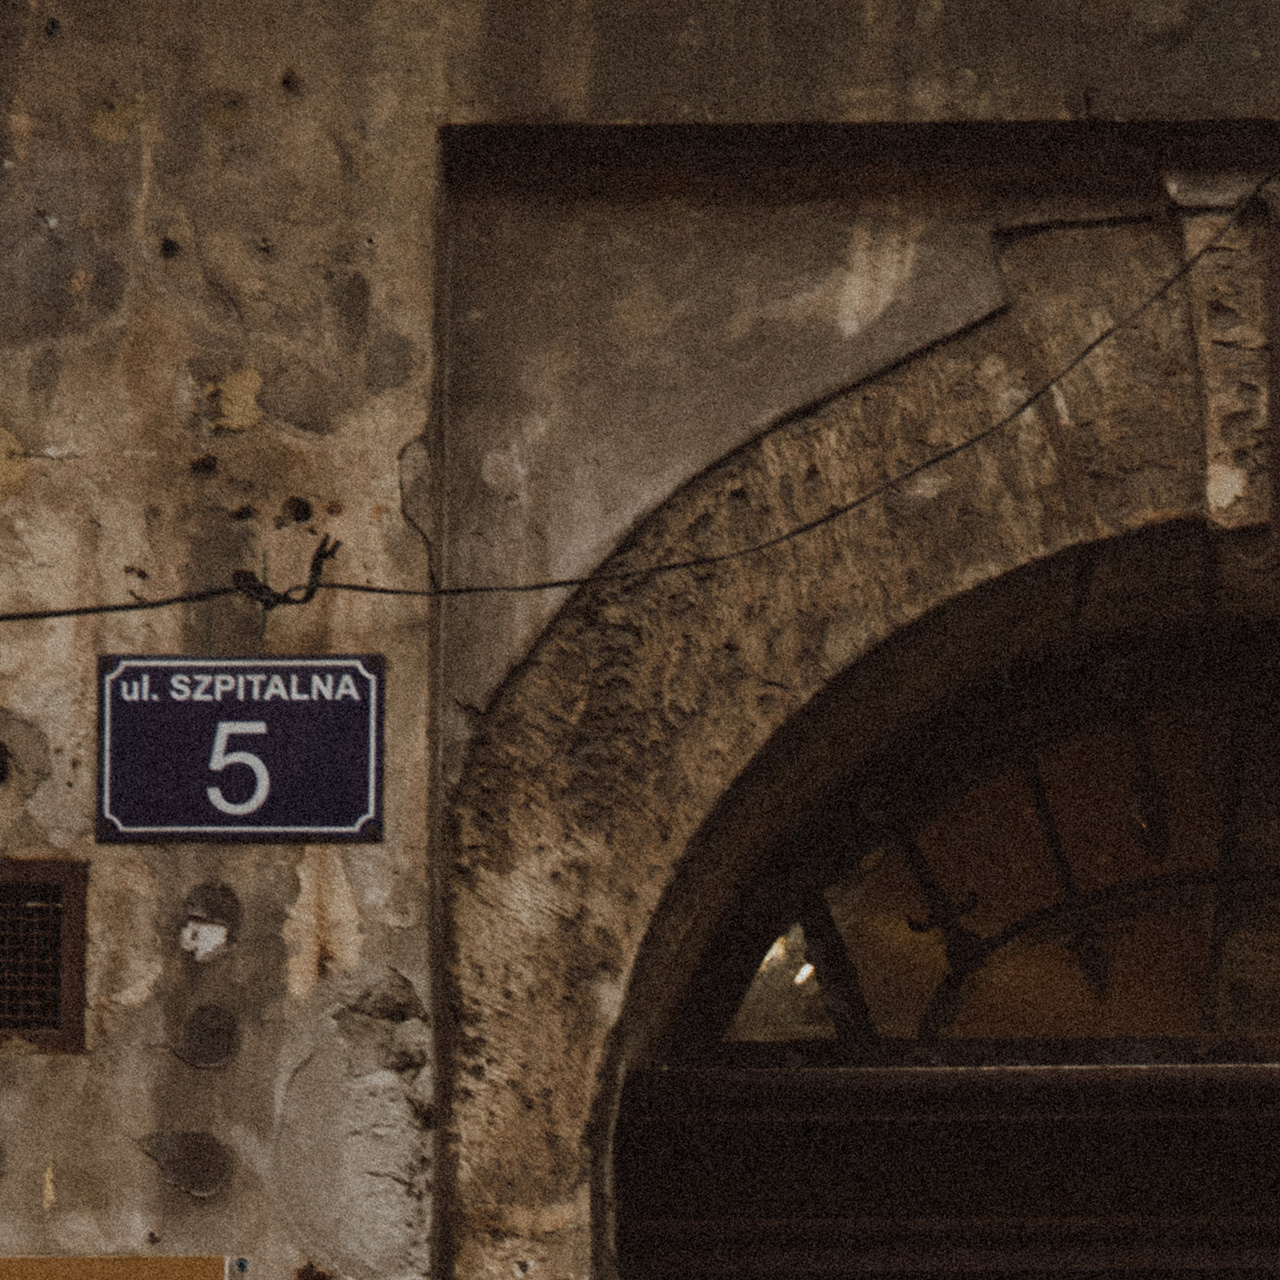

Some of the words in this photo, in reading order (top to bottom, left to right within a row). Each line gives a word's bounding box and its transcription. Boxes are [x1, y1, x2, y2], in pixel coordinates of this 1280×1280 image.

[120, 674, 159, 700] ul.
[169, 673, 361, 701] SZPITALNA
[206, 720, 271, 816] 5
